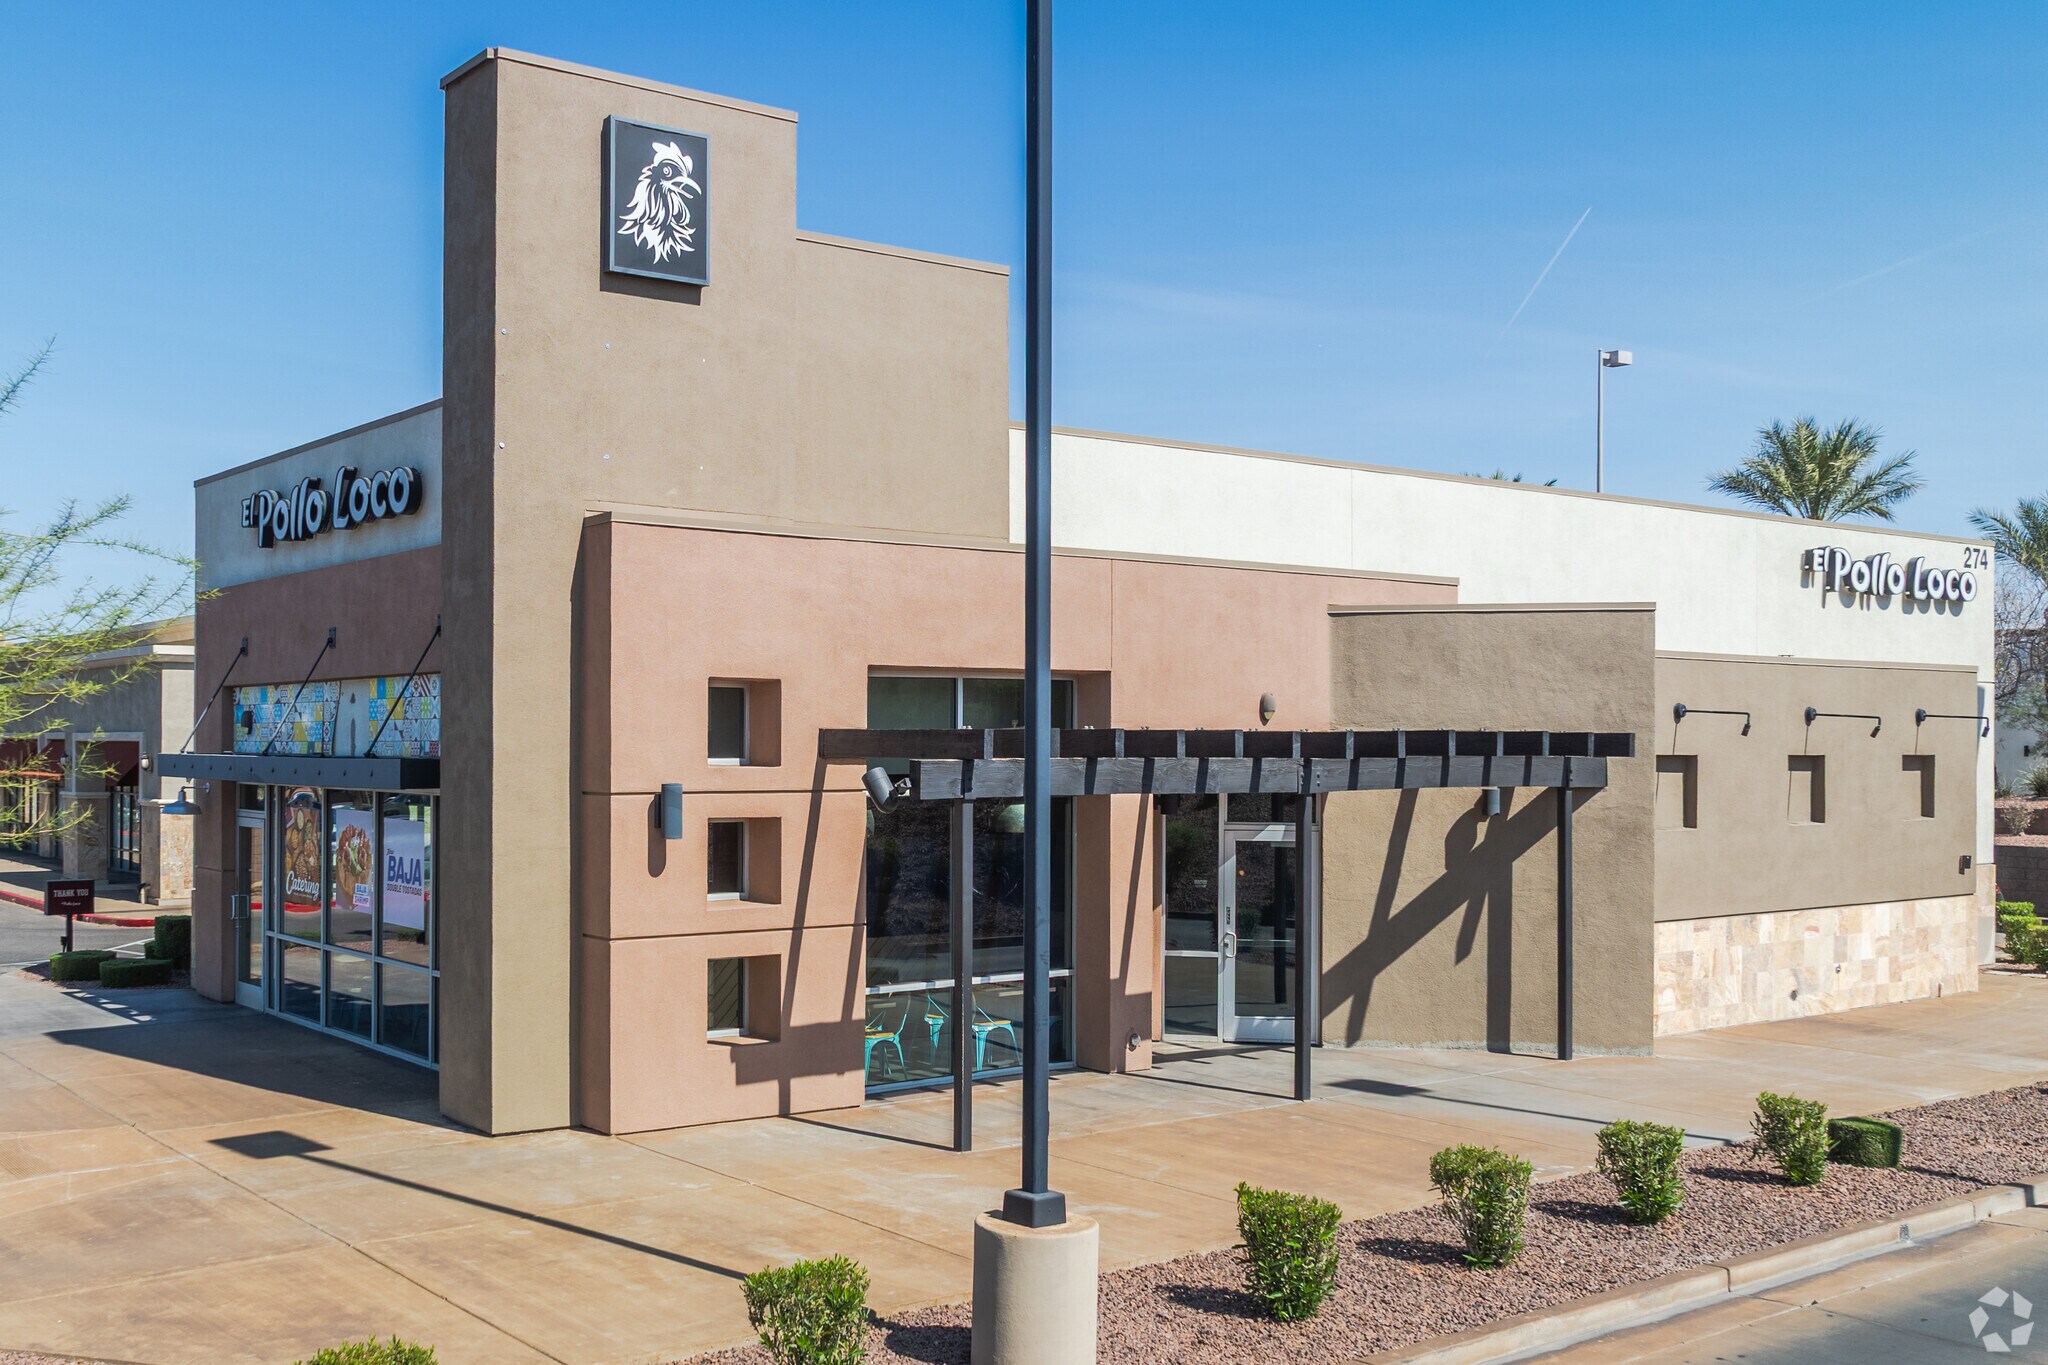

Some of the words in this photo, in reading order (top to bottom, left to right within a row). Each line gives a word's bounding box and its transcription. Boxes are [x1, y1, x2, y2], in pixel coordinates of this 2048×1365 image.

[241, 493, 259, 528] El
[258, 477, 331, 548] Pollo
[333, 466, 421, 530] Loco
[1809, 546, 1831, 572] El
[1831, 547, 1905, 596] Pollo
[1909, 557, 1977, 602] Loco
[1963, 547, 1988, 570] 274
[286, 870, 319, 901] Catering
[387, 855, 422, 886] BAJA
[53, 889, 75, 897] THANK
[76, 888, 89, 896] YOU
